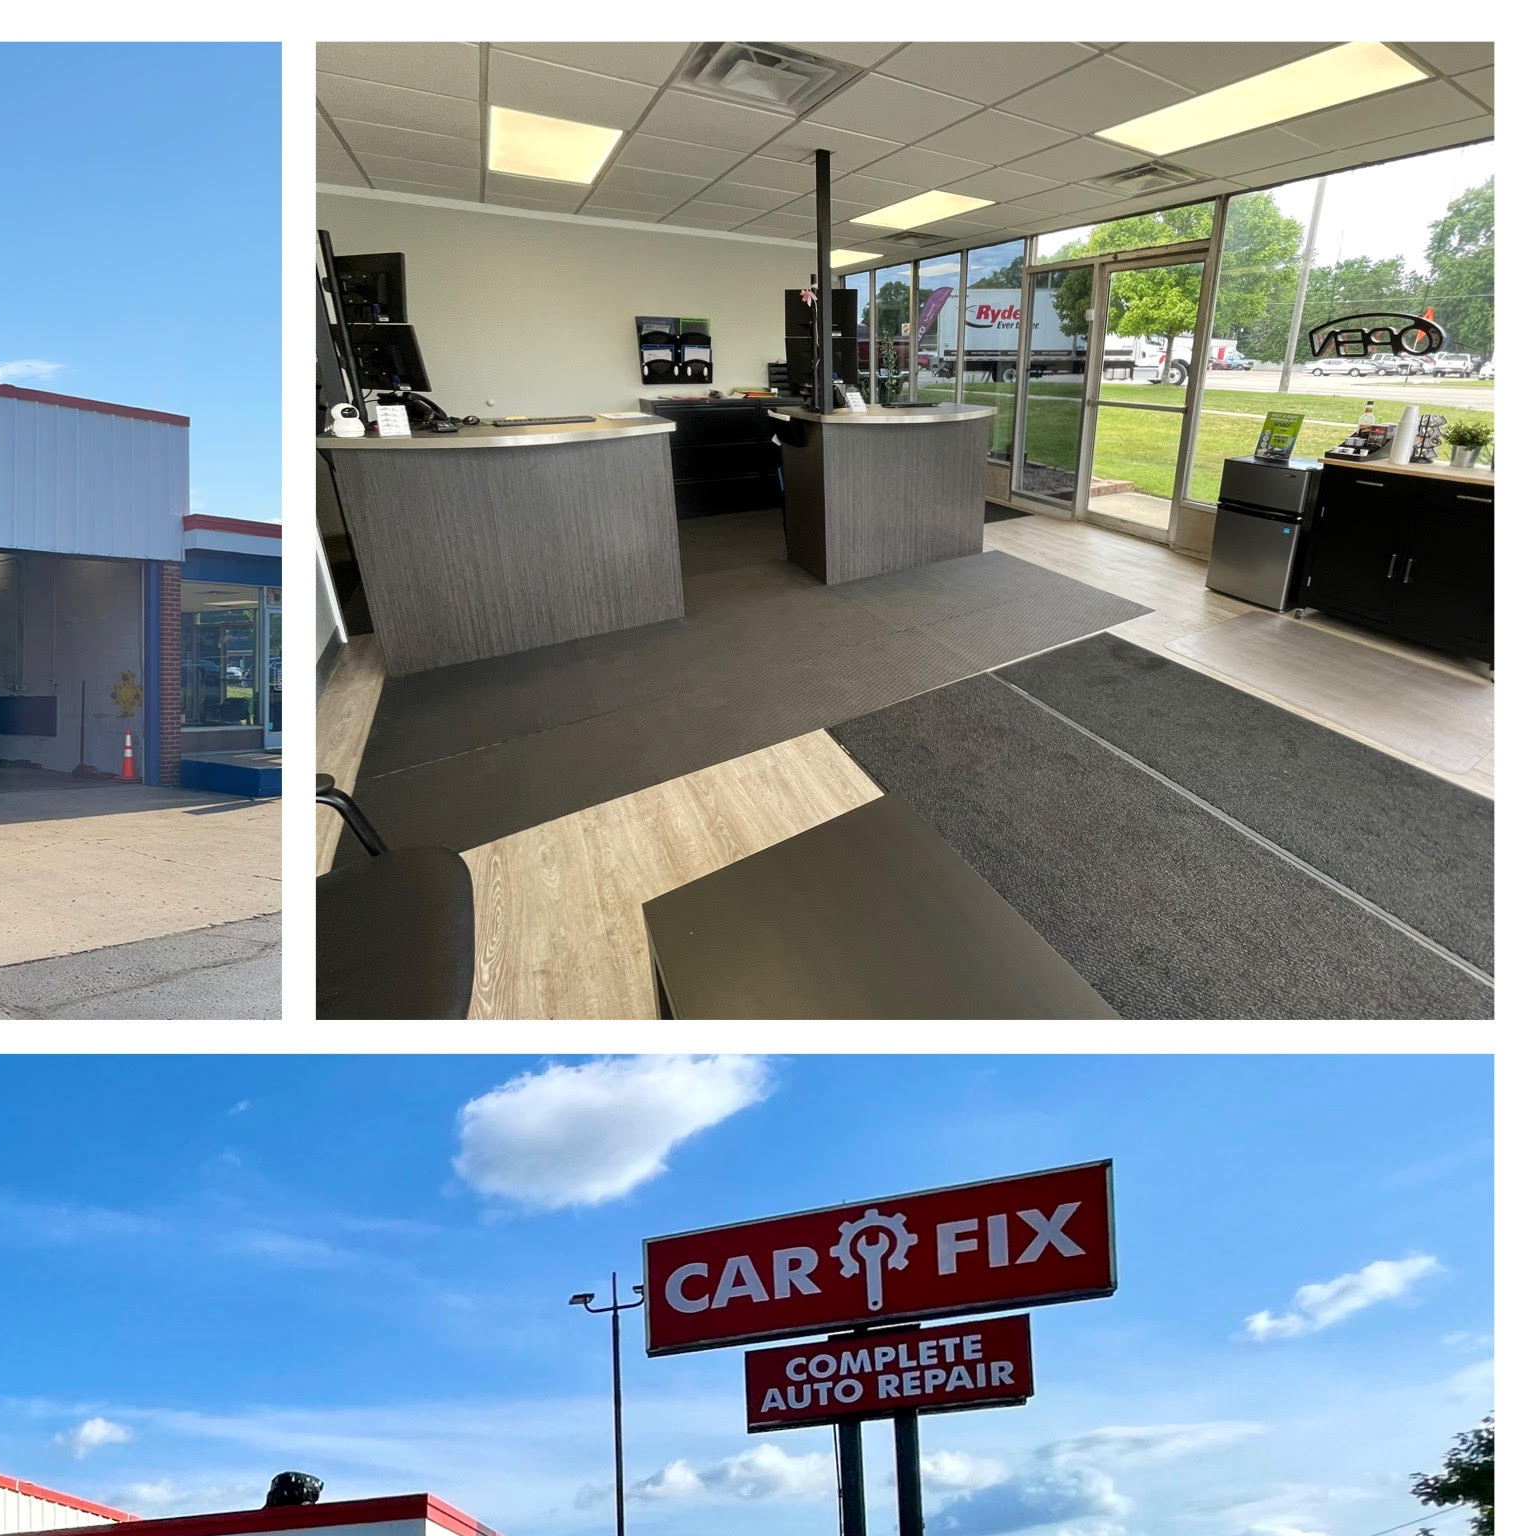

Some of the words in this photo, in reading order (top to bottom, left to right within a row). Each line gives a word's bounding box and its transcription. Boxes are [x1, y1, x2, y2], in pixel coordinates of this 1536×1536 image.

[976, 305, 1023, 323] Ryde
[997, 321, 1013, 329] Ever
[665, 1246, 821, 1313] CAR
[936, 1201, 1086, 1276] FIX
[785, 1333, 983, 1381] COMPLETE
[760, 1378, 864, 1413] AUTO
[878, 1360, 1015, 1399] REPAIR
